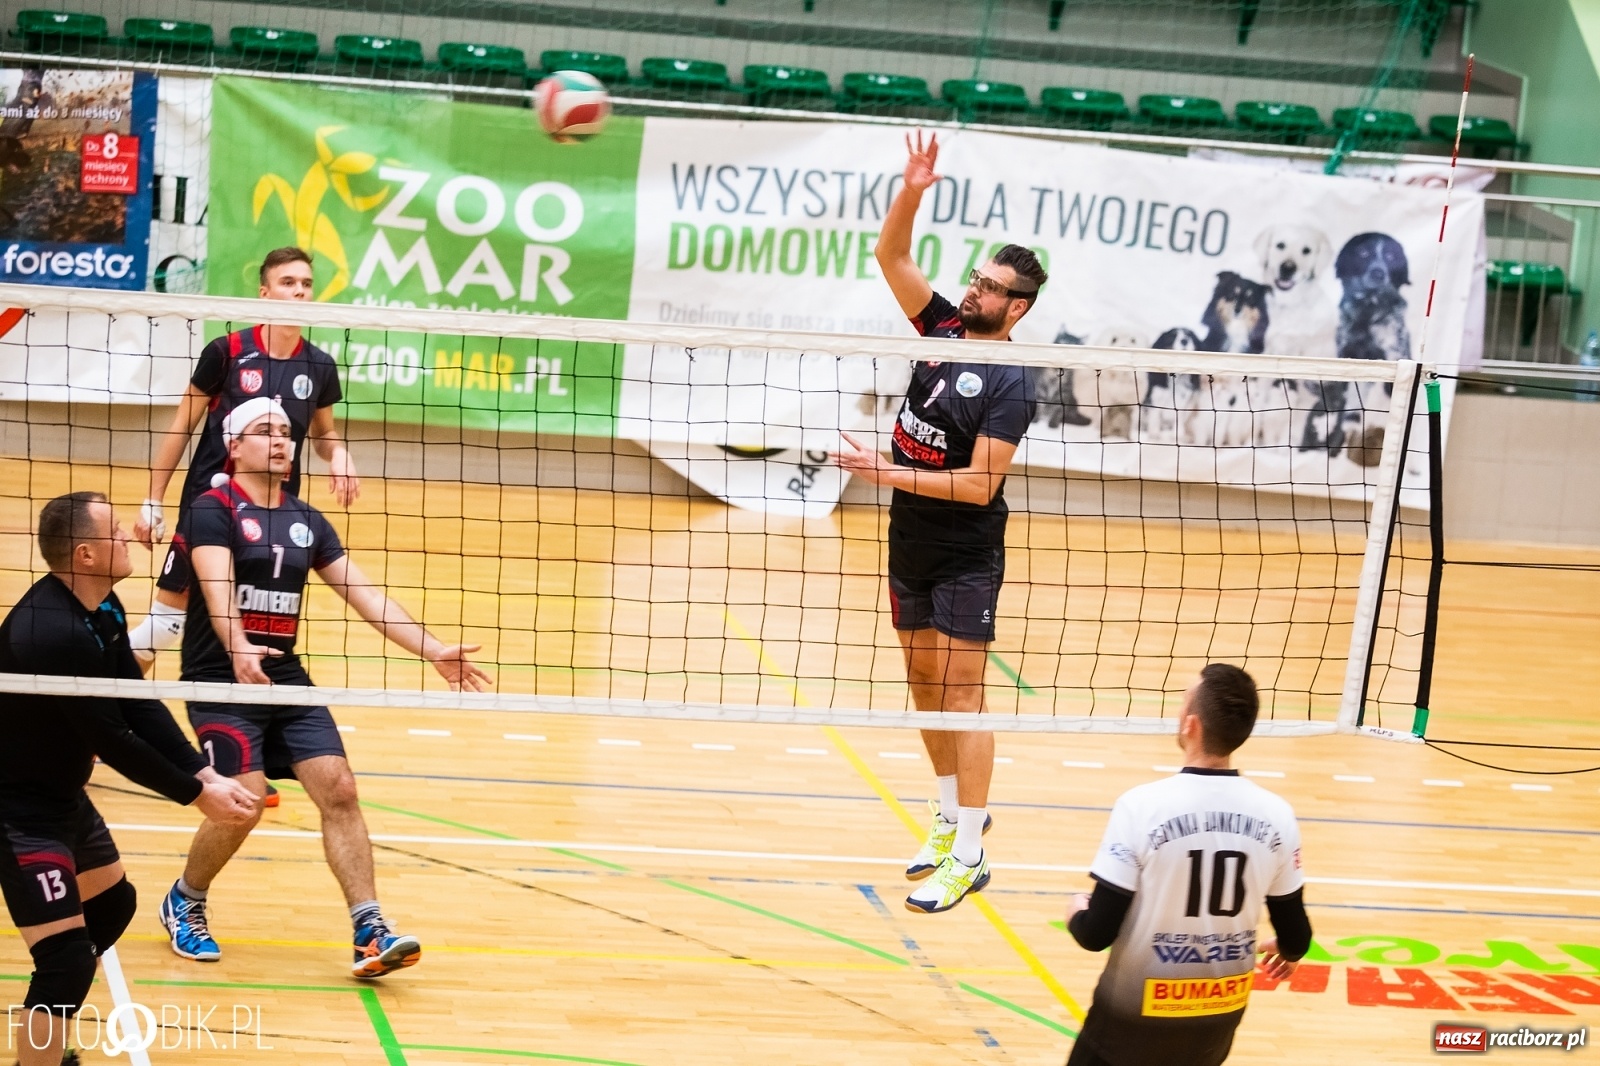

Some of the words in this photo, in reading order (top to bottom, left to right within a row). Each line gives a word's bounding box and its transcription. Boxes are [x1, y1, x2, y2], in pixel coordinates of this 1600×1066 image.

[42, 105, 58, 118] do
[85, 141, 100, 152] Do
[102, 132, 119, 159] 8
[84, 174, 129, 187] ochrony
[372, 165, 584, 242] ZOO
[932, 175, 1009, 232] DLA
[1030, 186, 1230, 258] TWOJEGO
[352, 228, 574, 306] MAR
[667, 221, 943, 283] DOMOWEO
[163, 550, 176, 575] 8
[37, 869, 67, 902] 13
[1184, 849, 1248, 917] 10
[1153, 977, 1248, 1000] BUMART
